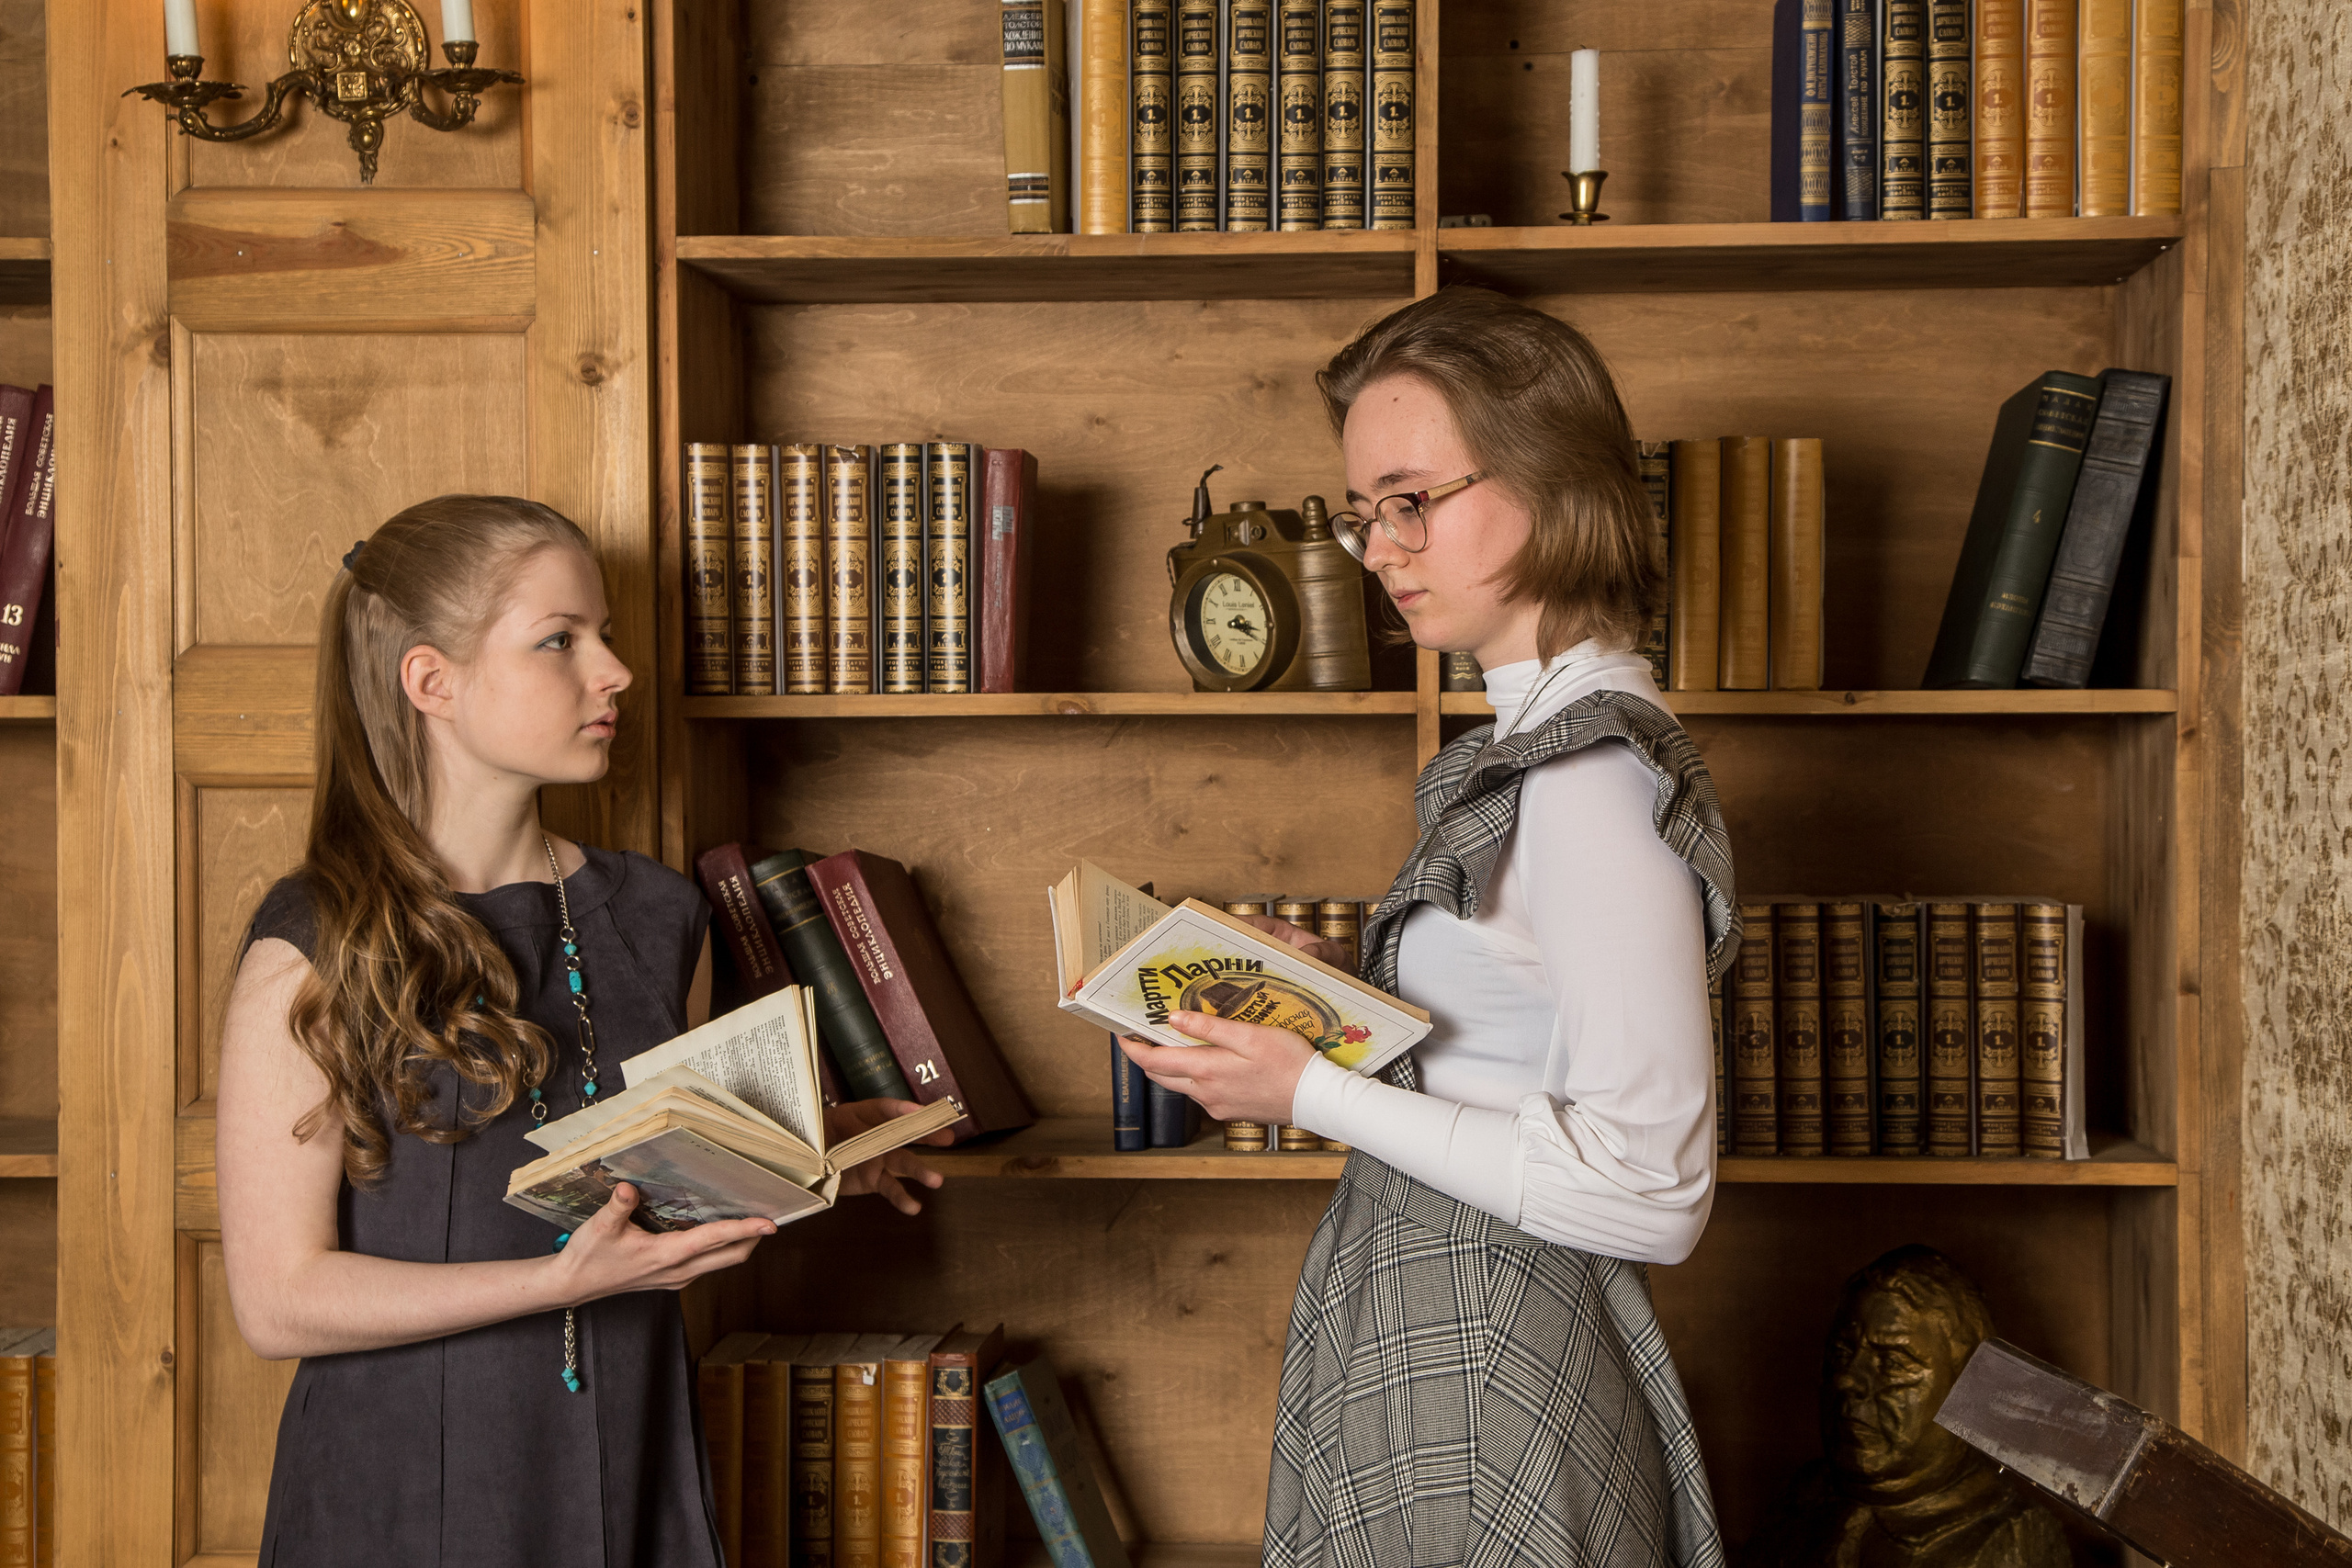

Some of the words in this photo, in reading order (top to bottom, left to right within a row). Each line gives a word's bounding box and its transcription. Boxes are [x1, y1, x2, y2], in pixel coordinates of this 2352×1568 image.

[25, 470, 42, 516] БОЛЬШАЯ
[36, 412, 53, 468] СОВЕТСКАЯ
[1233, 578, 1241, 592] XII
[1, 603, 24, 626] 13
[718, 879, 743, 933] СОВЕТСКАЯ
[729, 874, 774, 976] ЭНЦИКЛОПЕДИЯ
[831, 887, 860, 940] СОВЕТСКАЯ
[842, 882, 894, 981] ЭНЦИКЛОПЕДИЯ
[740, 935, 763, 979] БОЛЬШАЯ
[856, 942, 882, 985] БОЛЬШАЯ
[1138, 967, 1172, 1025] Мартти
[1159, 957, 1264, 990] Ларни
[1232, 991, 1270, 1022] ТВЕРТЫЙ
[1247, 999, 1281, 1025] ЗВОНОК
[915, 1058, 940, 1086] 21
